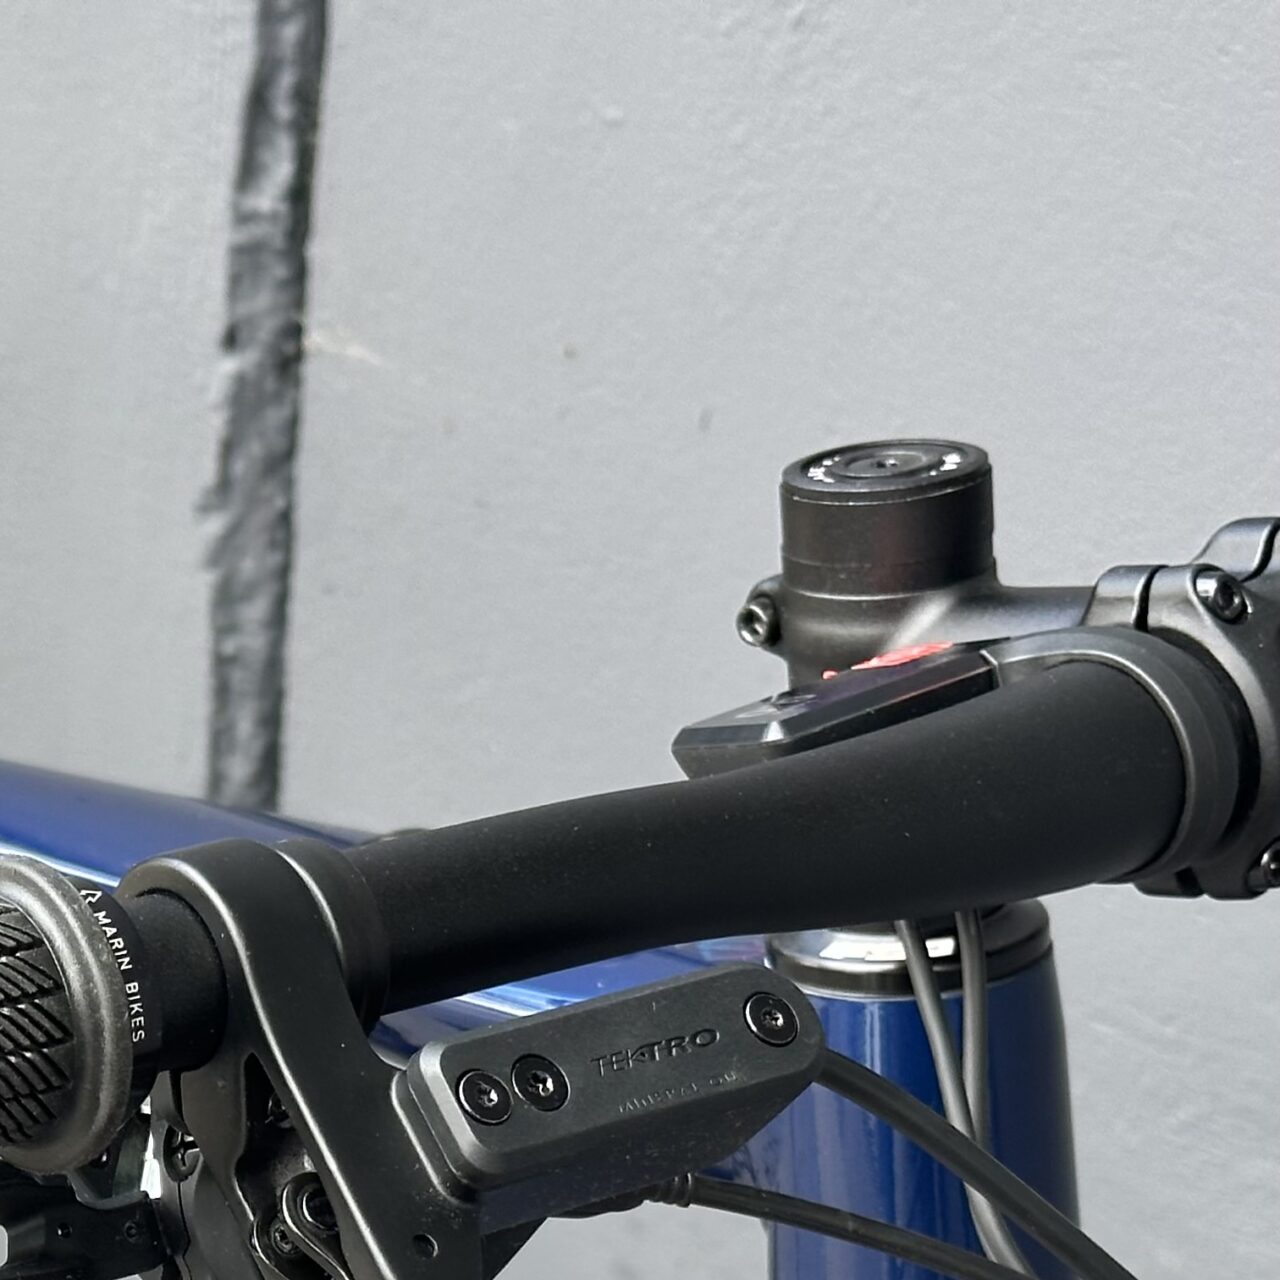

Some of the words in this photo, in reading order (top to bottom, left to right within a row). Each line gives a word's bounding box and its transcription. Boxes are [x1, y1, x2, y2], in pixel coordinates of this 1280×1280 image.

[93, 910, 133, 971] MARIN
[125, 981, 145, 1043] BIKES
[590, 1028, 720, 1077] TEKTRO
